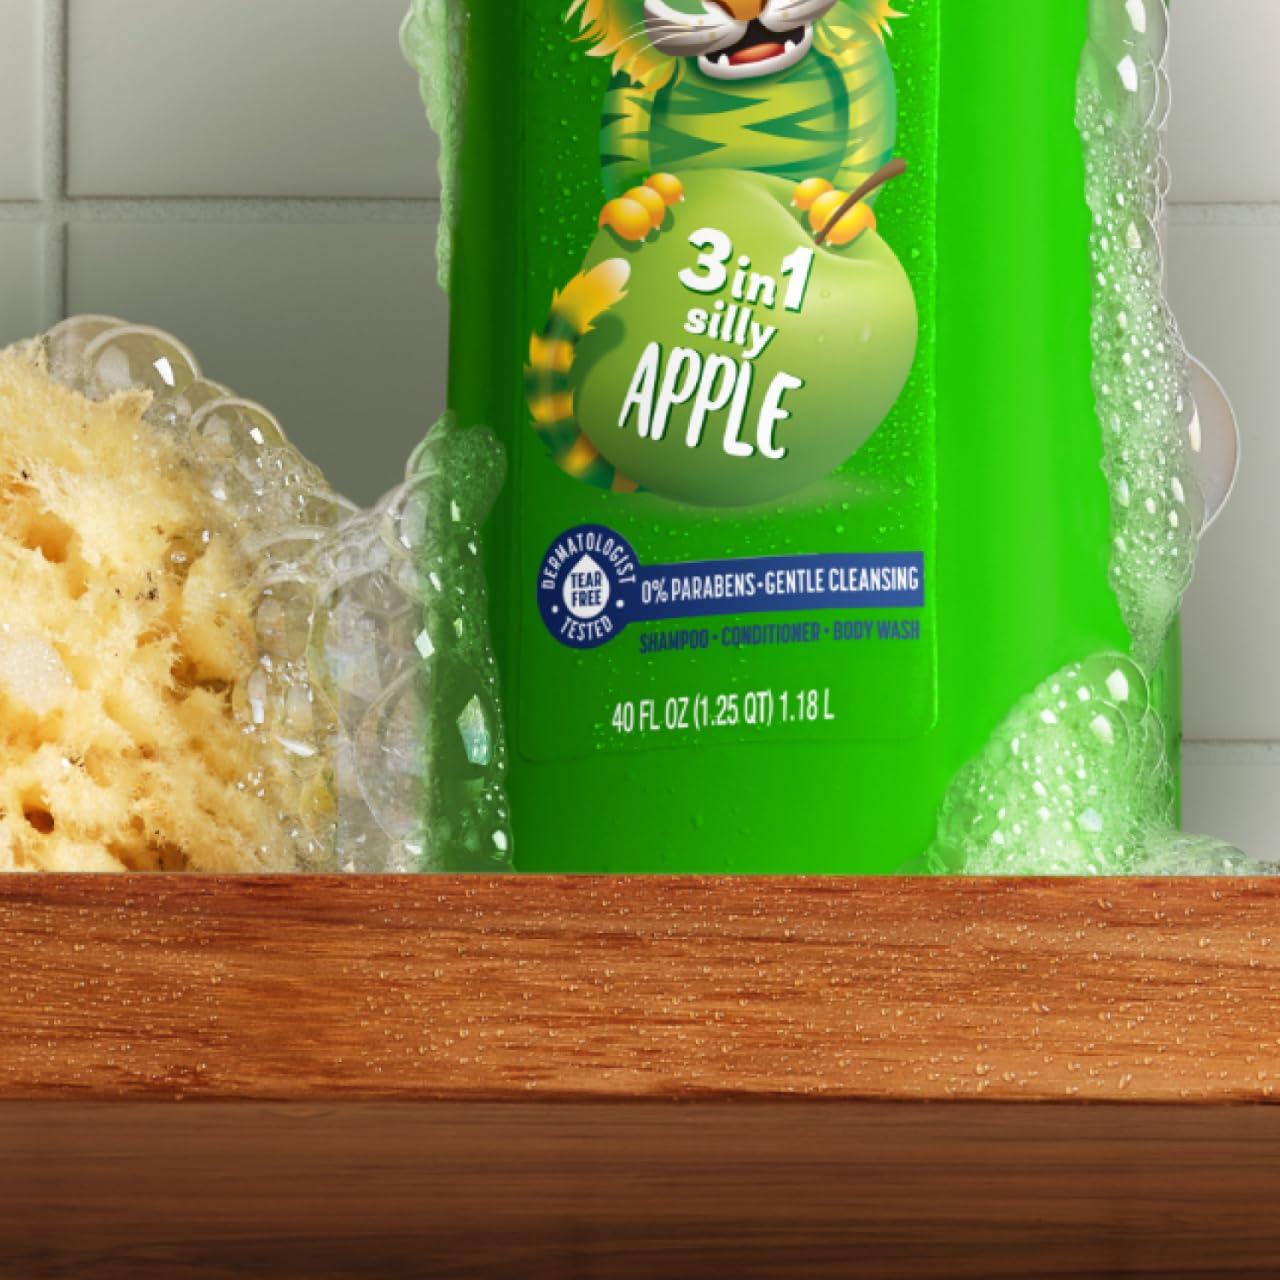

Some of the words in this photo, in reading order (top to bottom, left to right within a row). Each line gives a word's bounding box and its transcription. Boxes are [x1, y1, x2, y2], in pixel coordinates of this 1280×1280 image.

[683, 300, 776, 359] silly
[618, 341, 802, 459] APPLE
[541, 531, 637, 590] DERMATOLOGIST
[571, 570, 604, 589] TEAR
[571, 589, 604, 608] FREE
[641, 576, 669, 604] 0%
[828, 566, 919, 592] CLEANSING
[560, 615, 614, 641] TESTED
[640, 629, 710, 654] SHAMPOO
[721, 622, 820, 647] CONDITIONER
[833, 621, 873, 641] BODY
[877, 619, 921, 641] WASH
[611, 700, 635, 733] 40
[639, 698, 661, 731] FL
[665, 697, 689, 730] OZ
[693, 693, 739, 731] (1.25
[744, 689, 774, 726] QT)
[780, 689, 819, 722] 1.18
[824, 687, 835, 720] L
